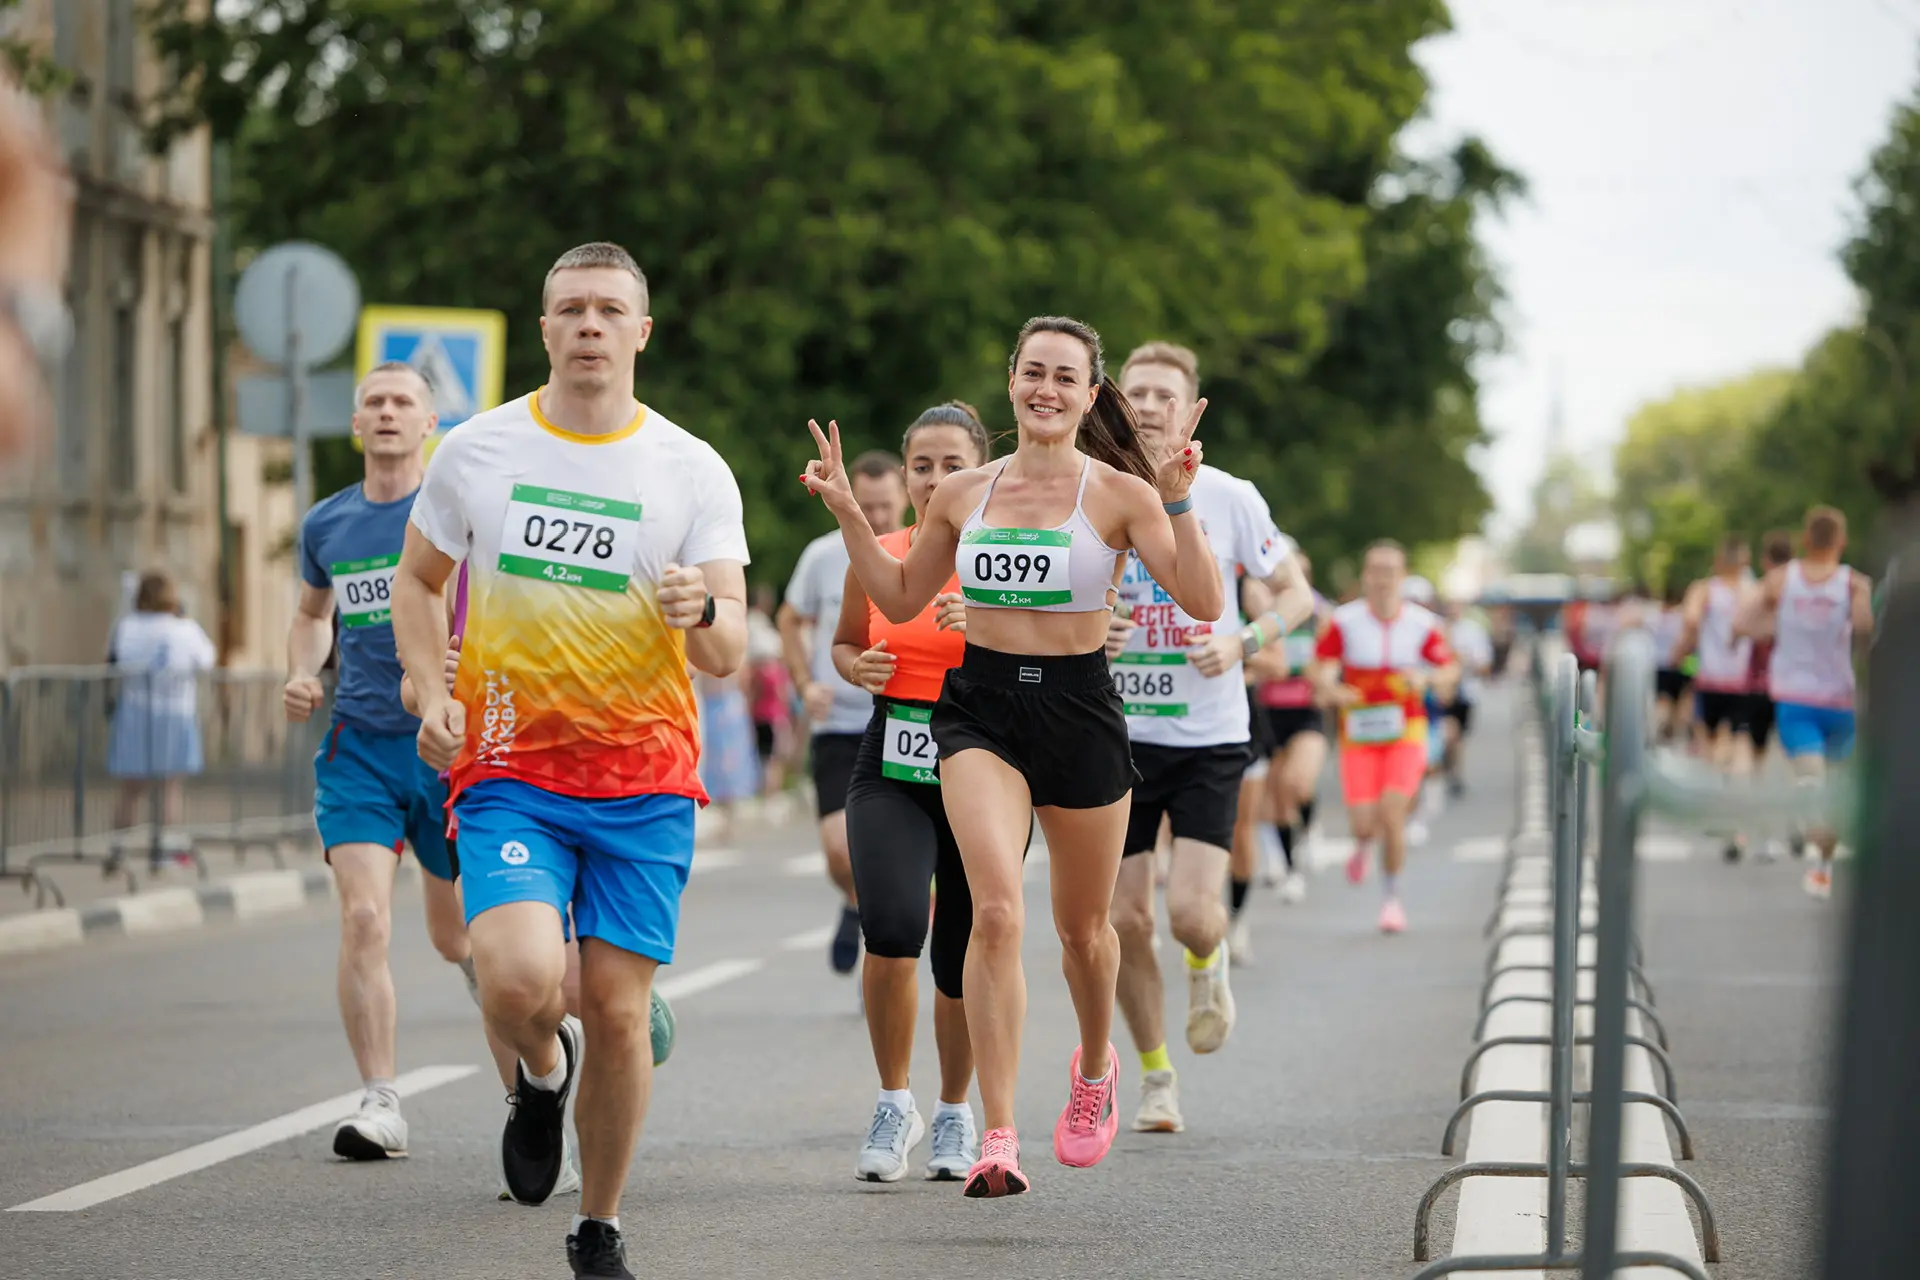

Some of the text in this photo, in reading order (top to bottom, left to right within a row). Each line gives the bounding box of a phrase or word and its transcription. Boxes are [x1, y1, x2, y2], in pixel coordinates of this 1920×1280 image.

[524, 515, 615, 559] 0278
[975, 553, 1050, 583] 0399
[346, 575, 396, 604] 038
[999, 593, 1031, 605] 4,2км
[1113, 672, 1173, 696] 0368
[897, 730, 938, 759] 02
